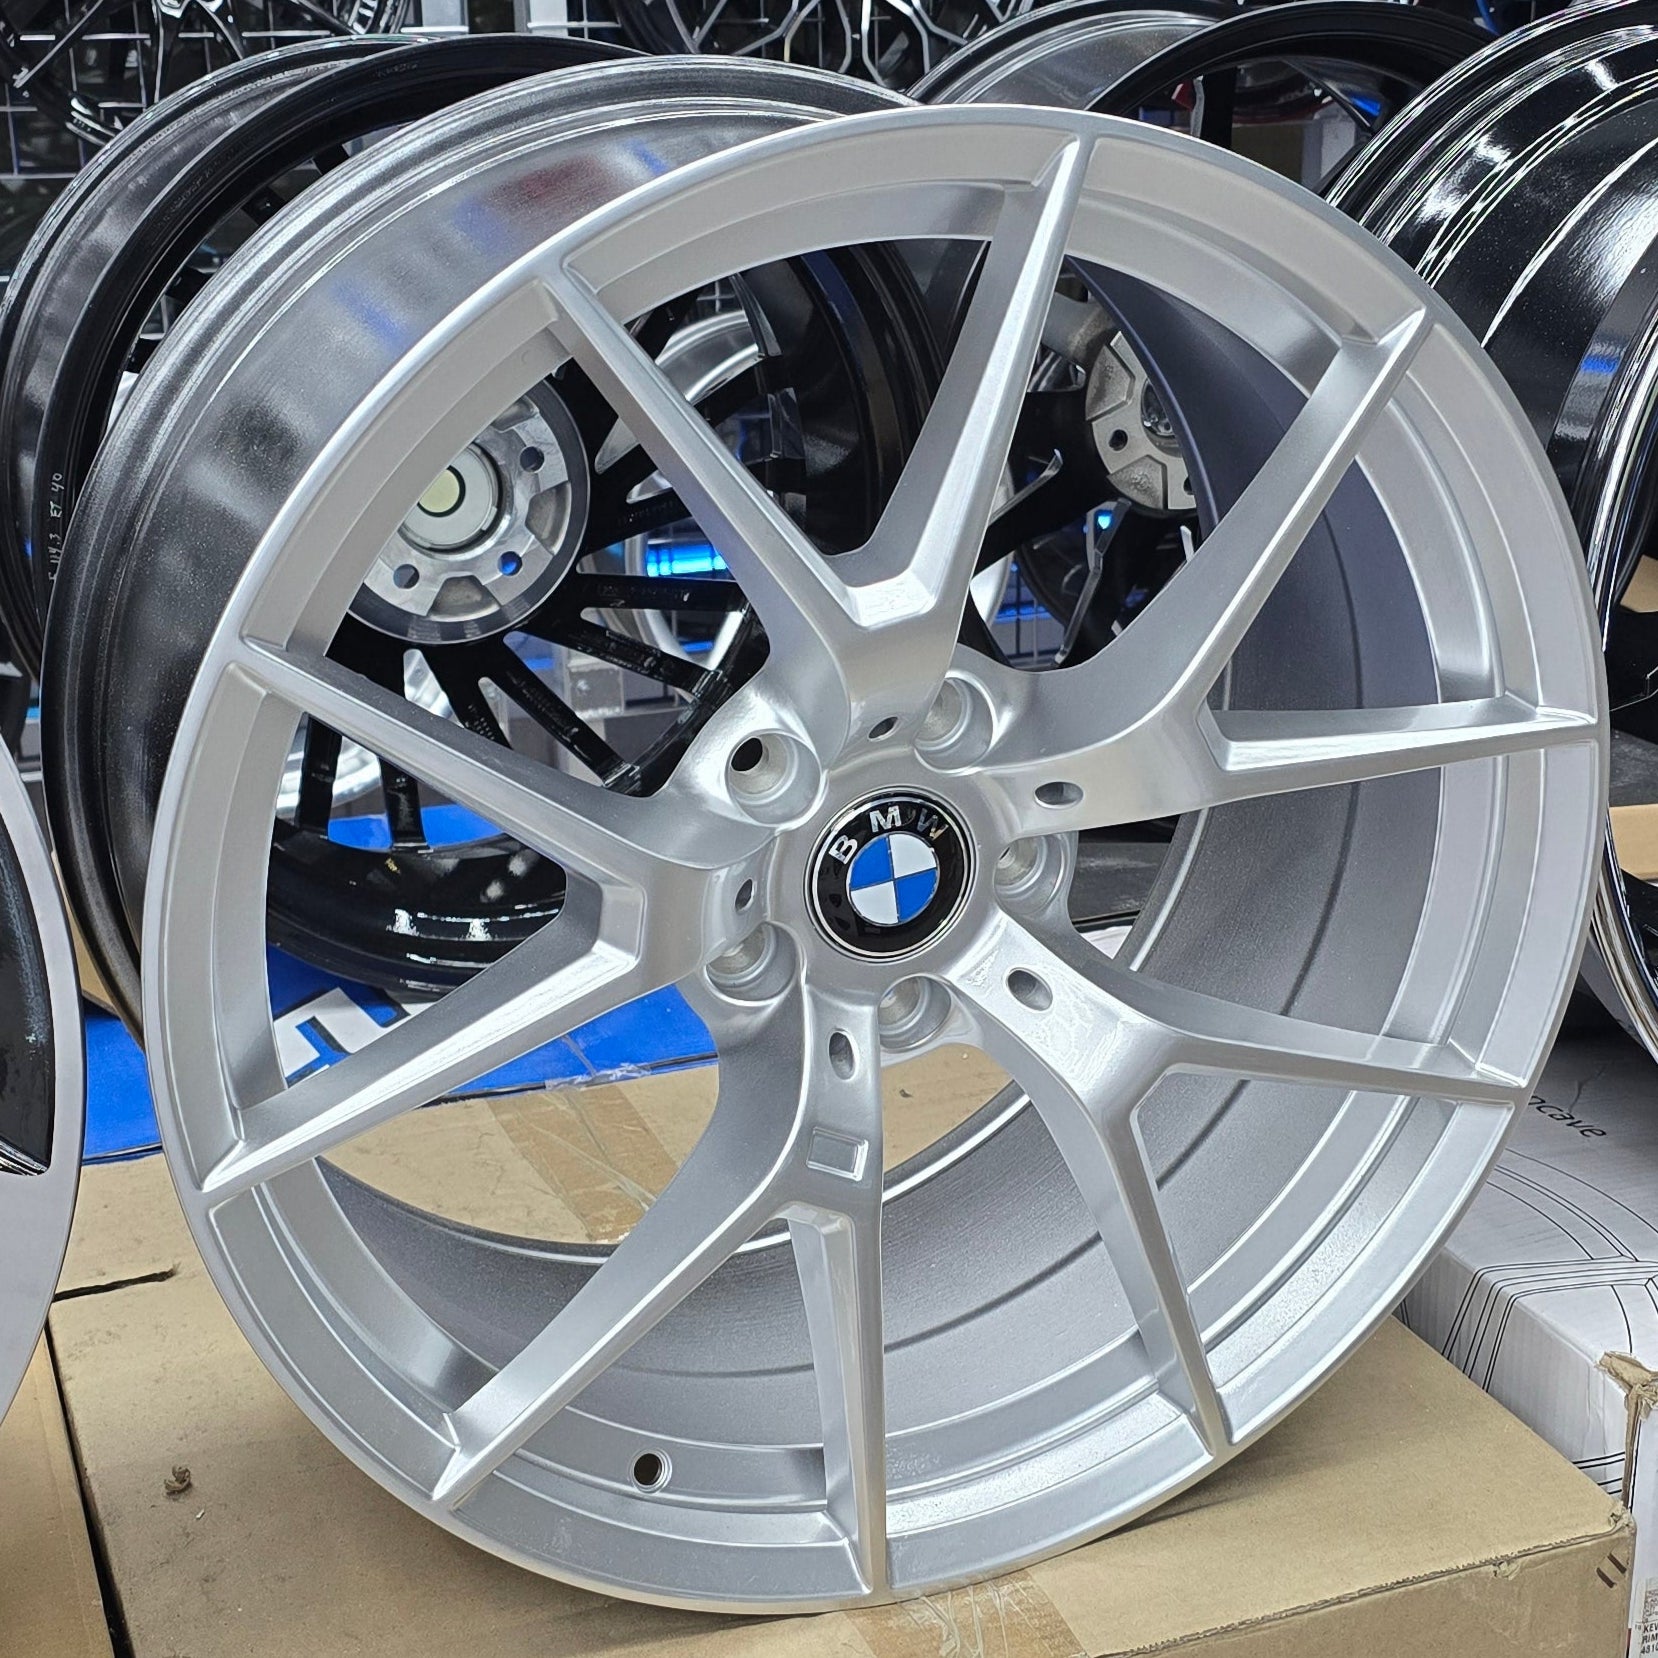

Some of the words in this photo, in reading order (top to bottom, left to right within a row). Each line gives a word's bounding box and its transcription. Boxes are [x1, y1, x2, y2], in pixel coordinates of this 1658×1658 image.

[50, 472, 64, 492] 40
[50, 501, 62, 518] ET
[828, 805, 949, 865] BMW
